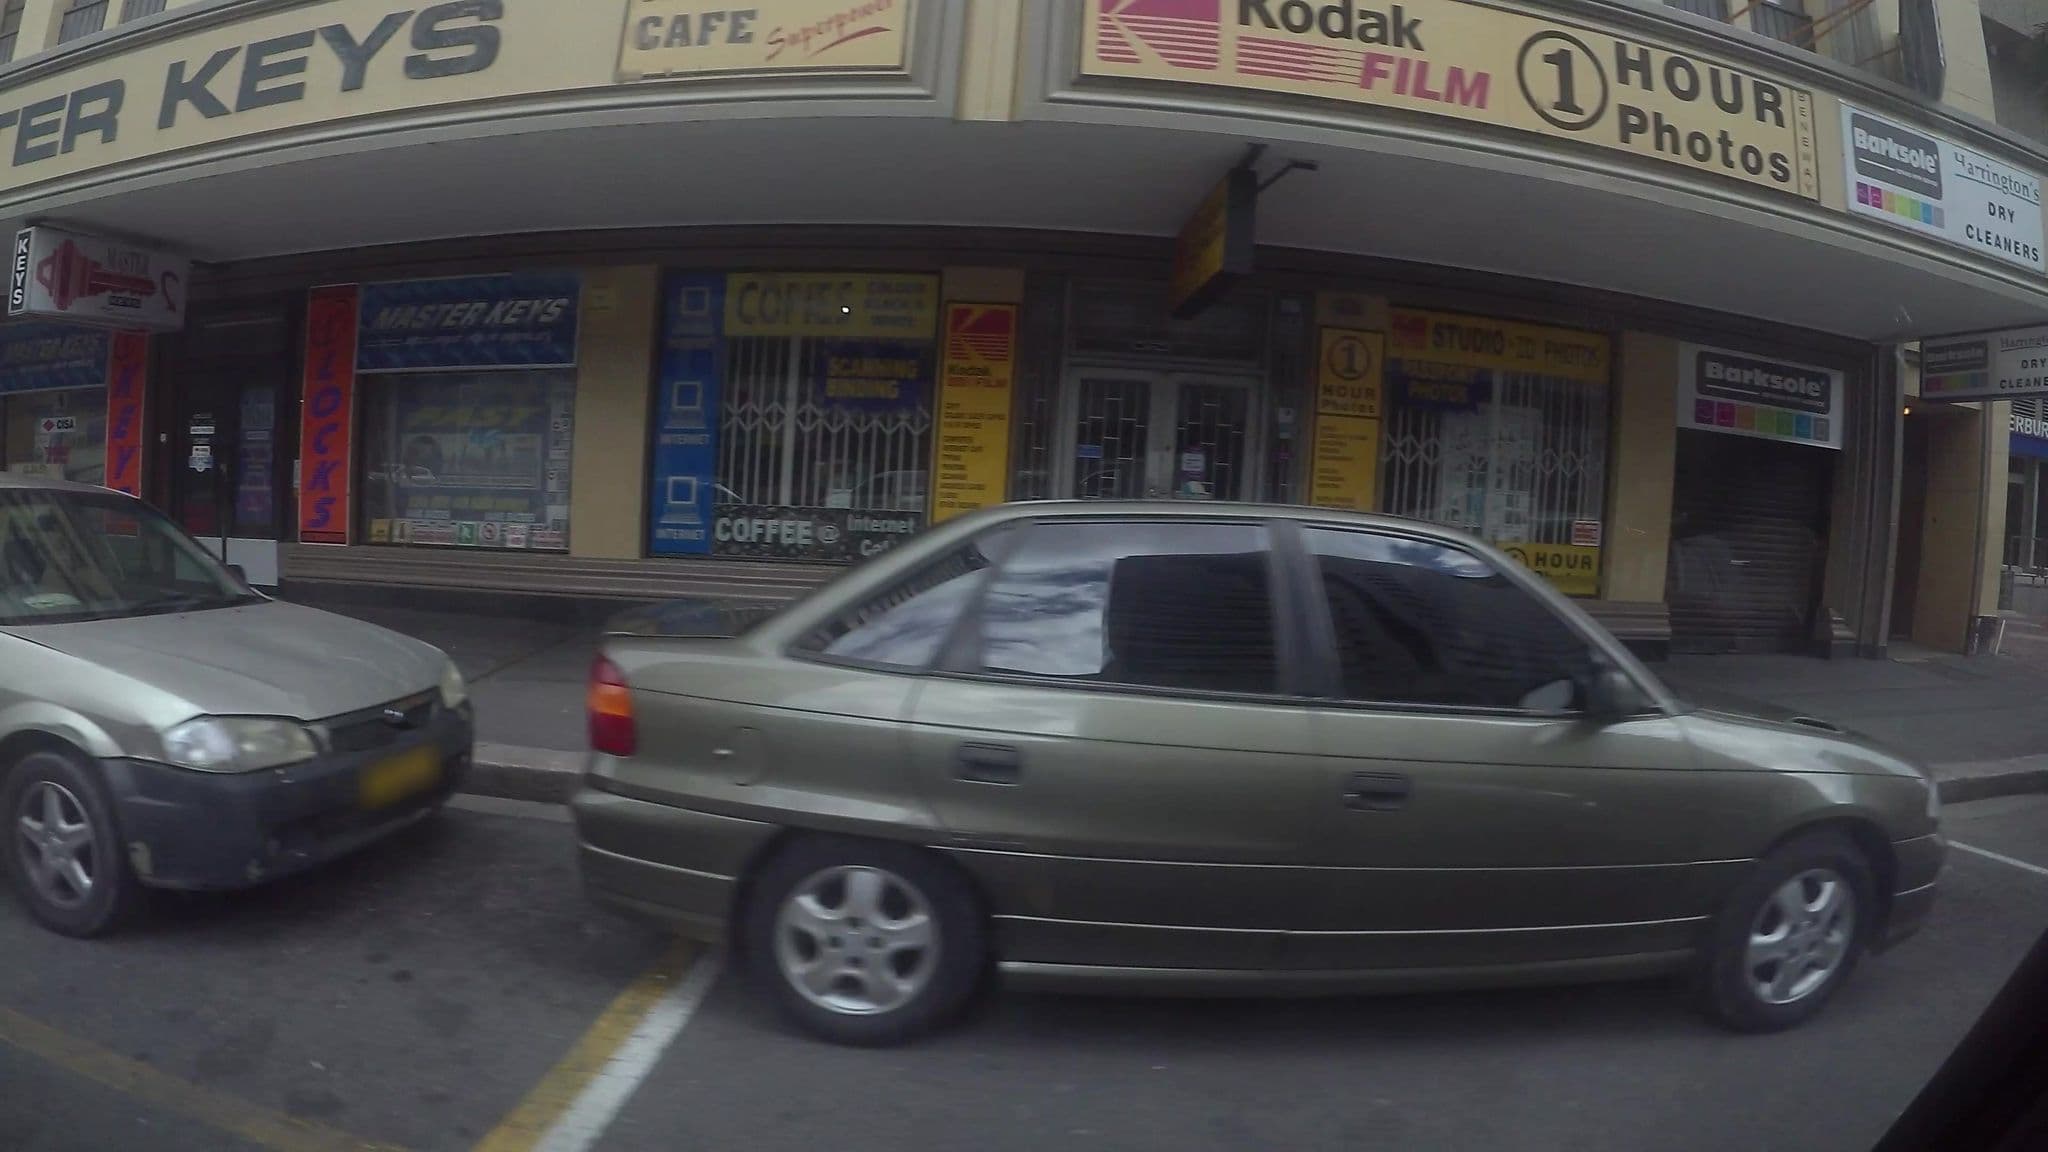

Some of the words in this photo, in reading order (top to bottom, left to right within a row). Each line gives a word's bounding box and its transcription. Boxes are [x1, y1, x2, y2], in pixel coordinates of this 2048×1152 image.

[635, 9, 758, 51] CAFE
[1239, 0, 1424, 51] Kodak
[157, 0, 503, 131] KEYS
[1360, 52, 1490, 109] FILM
[1613, 41, 1786, 128] HOUR
[1617, 103, 1790, 183] Photos
[1854, 128, 1937, 174] Barksole
[1955, 152, 2039, 201] Harrington's
[1988, 202, 2015, 223] DRY
[1966, 223, 2039, 262] CLEANERS
[13, 238, 29, 305] KEYS
[374, 302, 488, 330] MASTER
[485, 297, 569, 325] KEYS
[1705, 361, 1822, 397] Barksole
[2021, 358, 2047, 369] DRY
[1321, 384, 1375, 399] HOUR
[57, 419, 73, 429] CISA
[715, 517, 813, 545] COFFEE
[847, 515, 915, 534] Internet
[1535, 552, 1592, 570] HOUR
